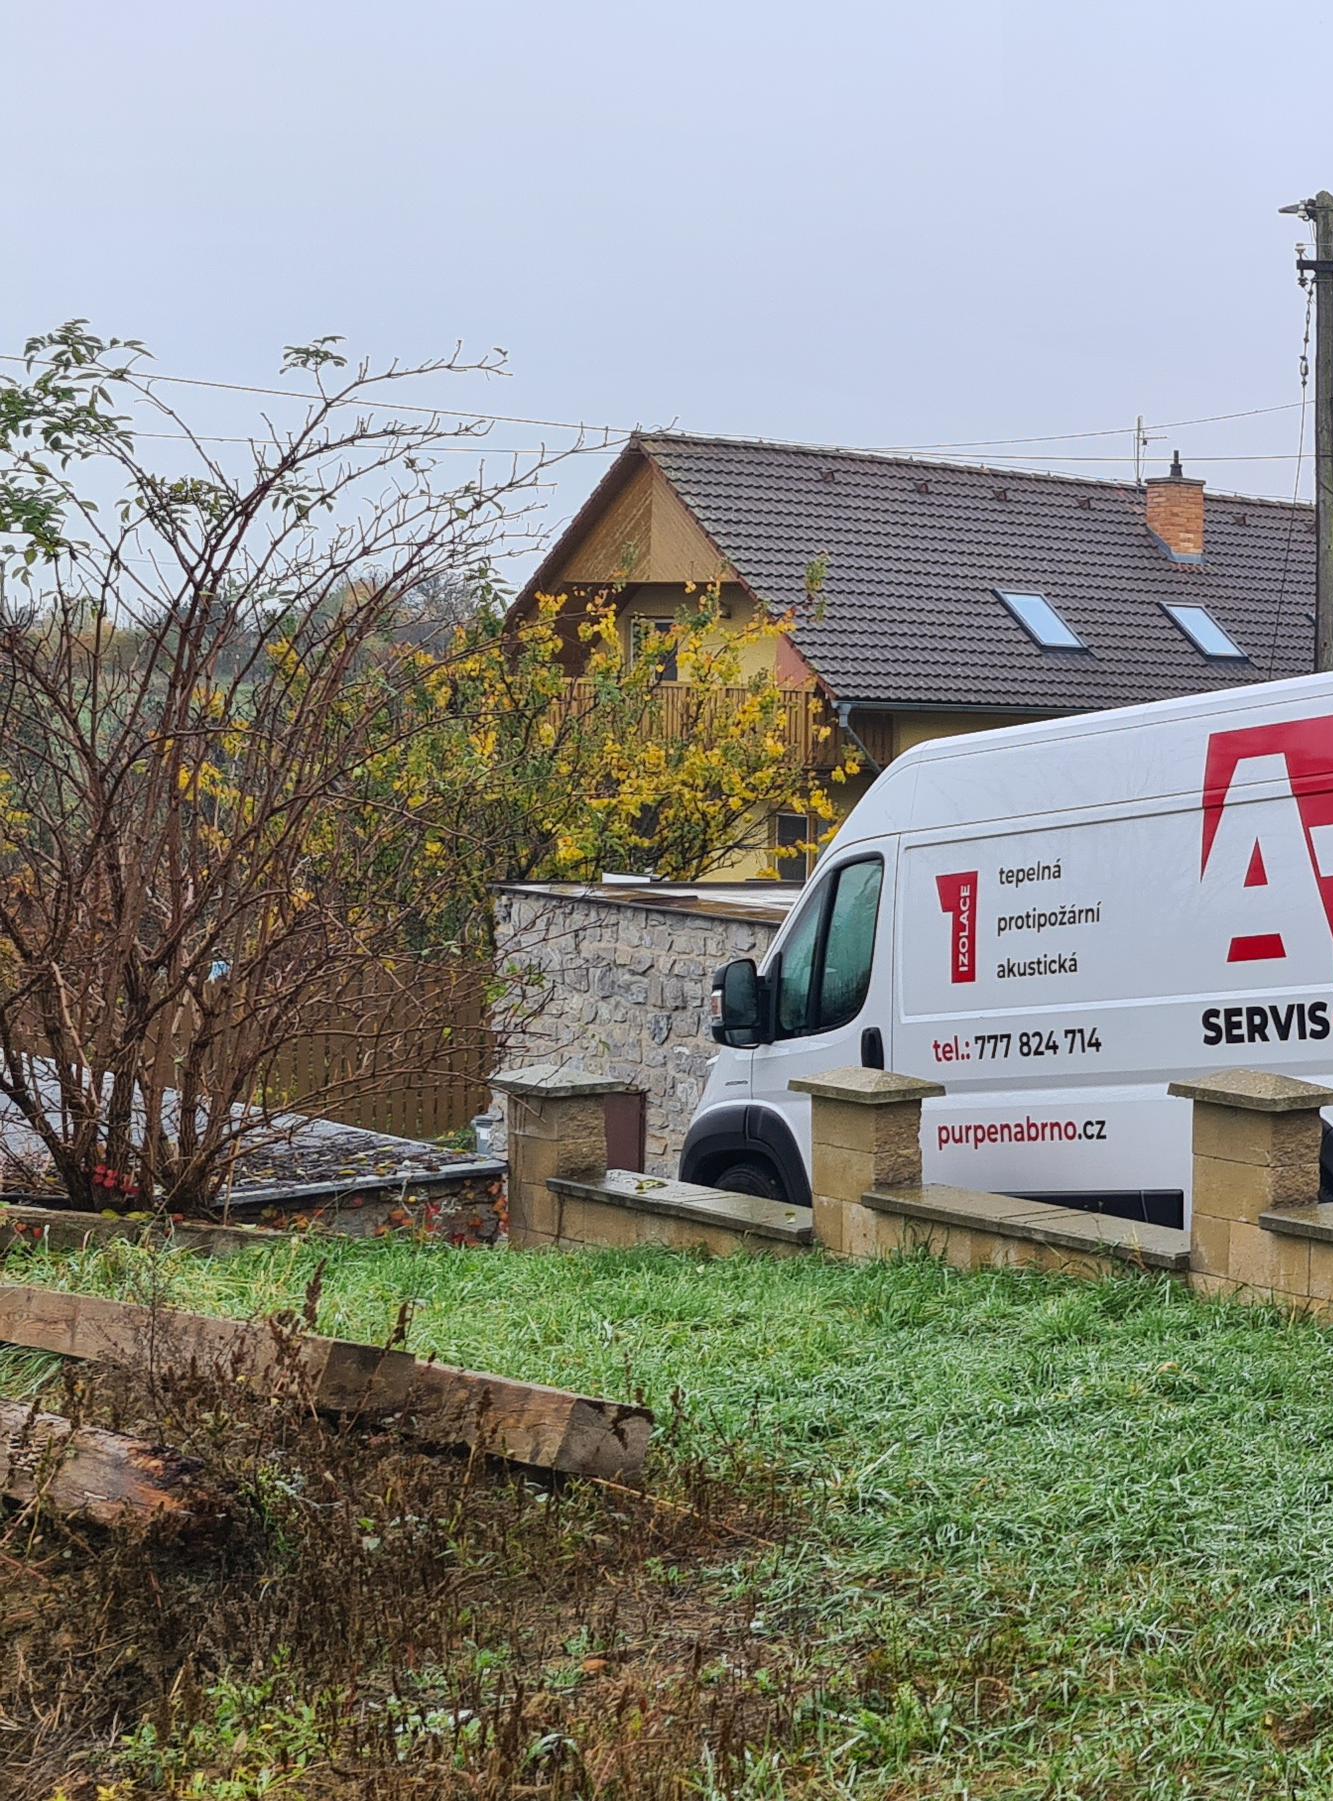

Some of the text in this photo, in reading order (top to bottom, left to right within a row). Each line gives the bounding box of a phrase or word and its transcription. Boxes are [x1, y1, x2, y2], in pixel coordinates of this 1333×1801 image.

[998, 858, 1062, 888] tepelná
[958, 884, 970, 972] IZOLACE
[997, 901, 1102, 937] protipožární
[996, 952, 1079, 979] akustická
[932, 1027, 1102, 1063] tel.: 777 824 714
[937, 1115, 1107, 1151] purpenabrno.cz
